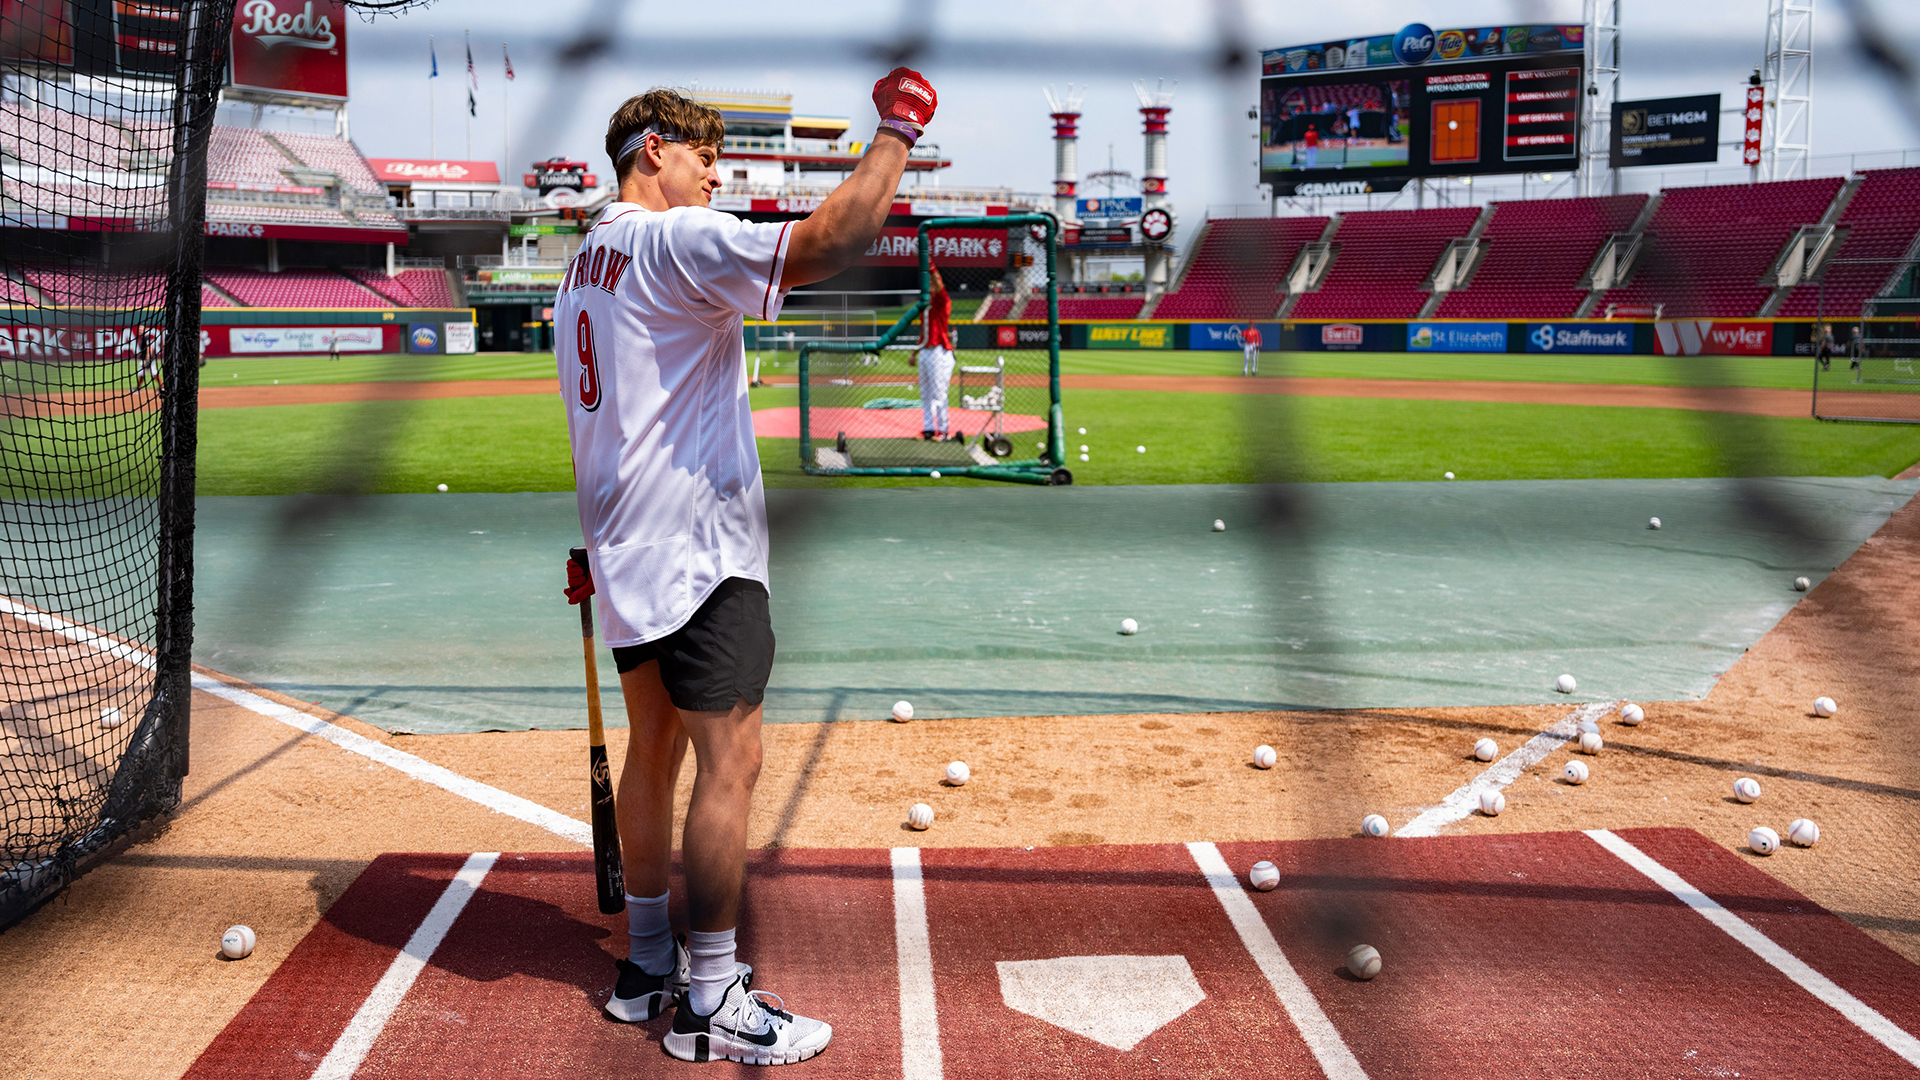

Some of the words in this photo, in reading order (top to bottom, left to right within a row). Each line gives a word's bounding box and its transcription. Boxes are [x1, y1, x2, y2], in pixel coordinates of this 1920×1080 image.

[241, 0, 336, 49] Reds
[1402, 34, 1433, 52] P&G
[901, 80, 933, 101] Franklin
[1647, 110, 1708, 127] BETMGM
[540, 174, 581, 186] TUNDRA
[1303, 181, 1368, 196] GRAVITY
[1101, 199, 1130, 212] PNC
[207, 222, 250, 237] PARK
[933, 237, 987, 258] PARK
[1090, 327, 1130, 341] WEST
[1556, 329, 1627, 347] Staffmark
[1712, 327, 1767, 349] wyler
[1795, 342, 1847, 354] BETM
[577, 310, 602, 413] 9
